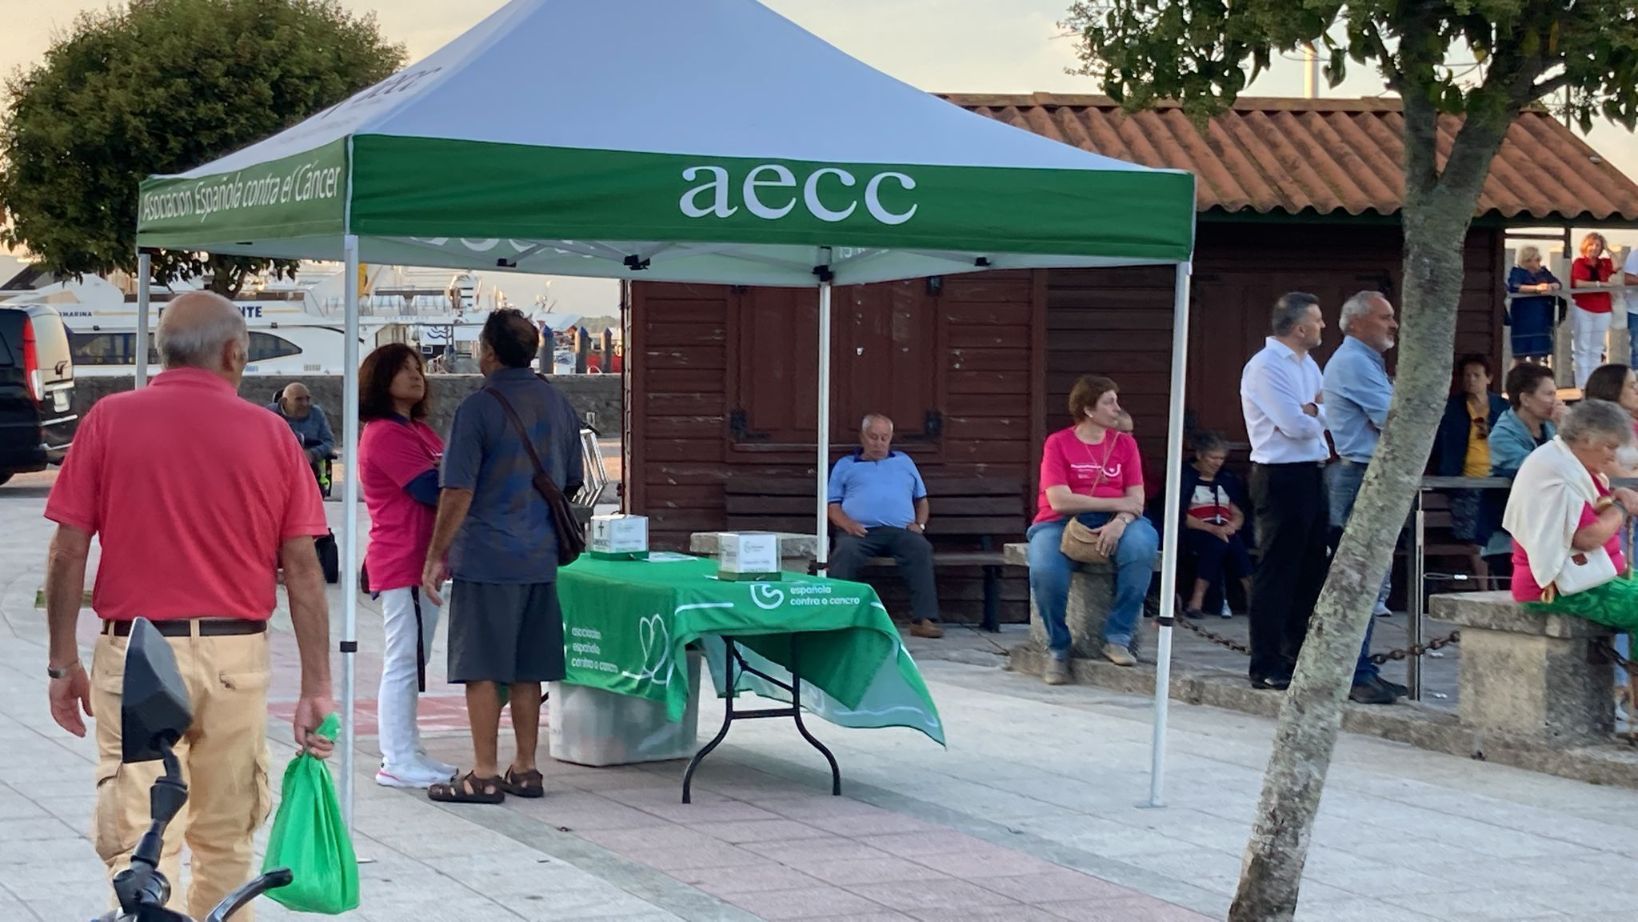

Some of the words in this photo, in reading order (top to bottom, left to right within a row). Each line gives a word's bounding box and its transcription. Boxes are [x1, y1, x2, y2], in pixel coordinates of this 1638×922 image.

[195, 171, 243, 223] Española
[243, 174, 281, 207] contra
[281, 171, 296, 203] el
[295, 160, 341, 201] Cáncer
[679, 164, 918, 225] aecc
[790, 597, 820, 606] contra
[829, 597, 860, 605] cancro
